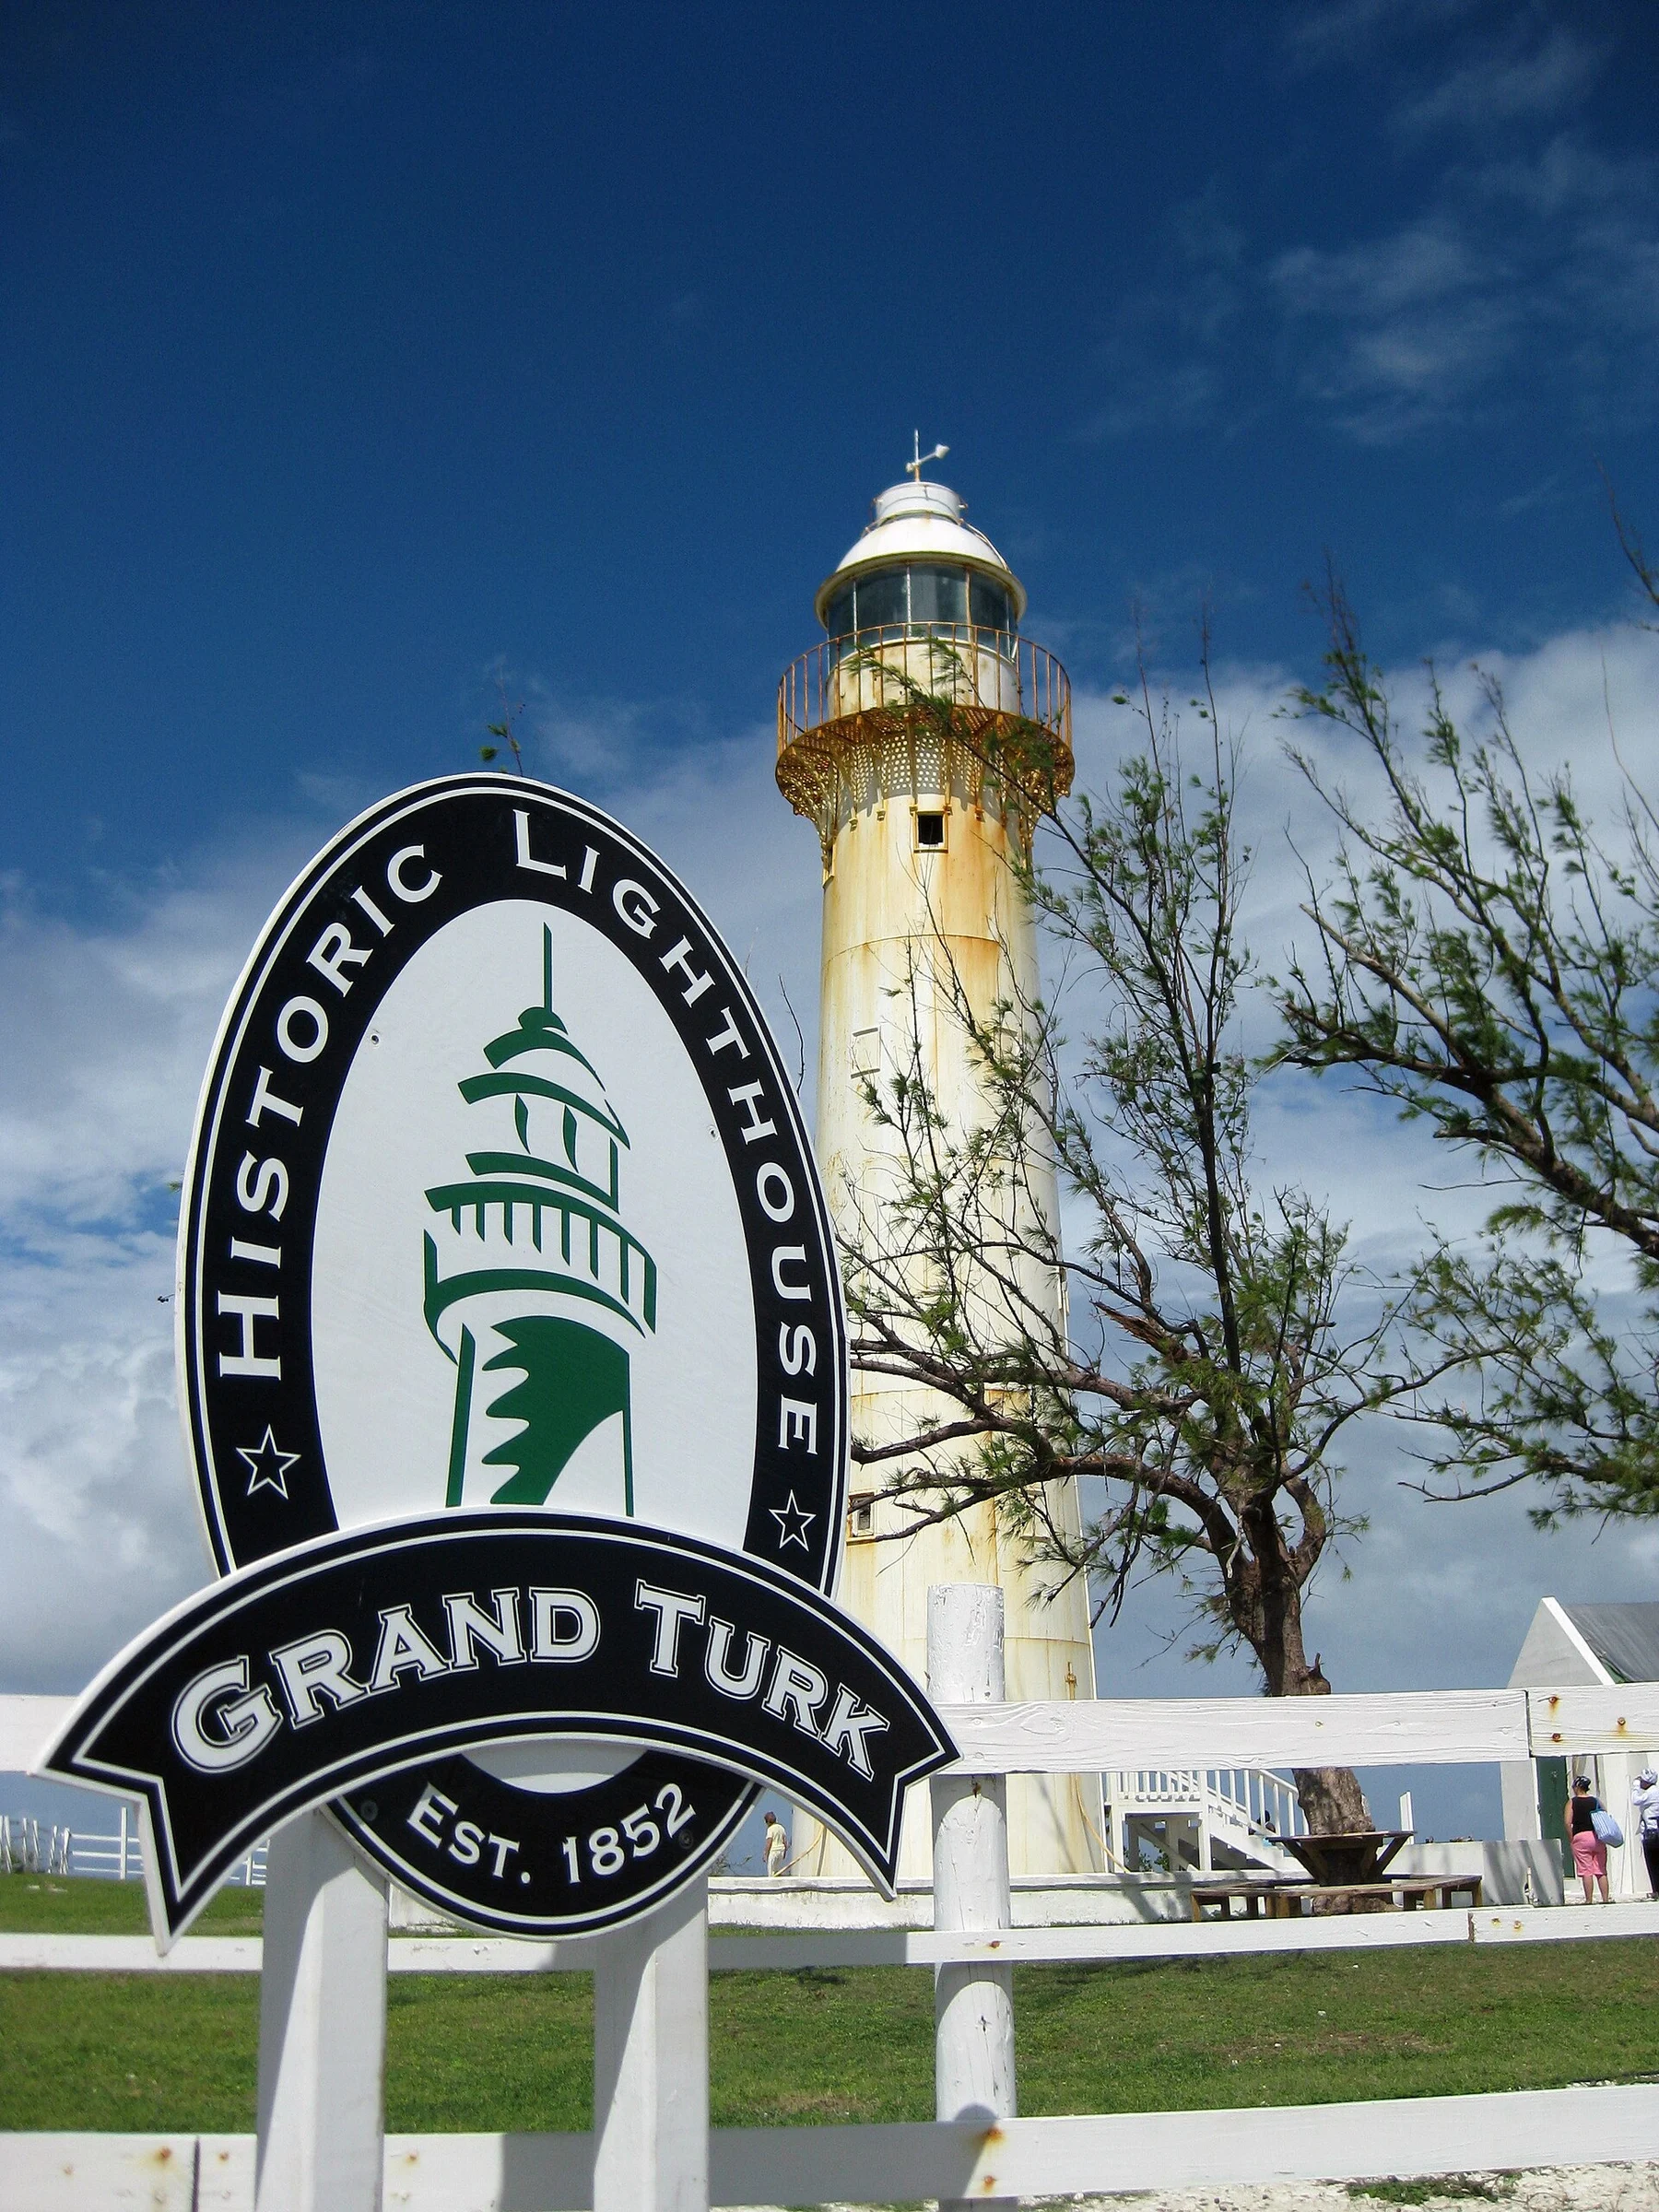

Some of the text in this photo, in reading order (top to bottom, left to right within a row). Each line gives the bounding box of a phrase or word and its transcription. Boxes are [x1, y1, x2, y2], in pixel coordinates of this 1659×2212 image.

[218, 809, 818, 1456] HISTORIC LIGHTHOUSE
[171, 1580, 890, 1782] GRAND TURK
[406, 1782, 697, 1885] EST. 1852
